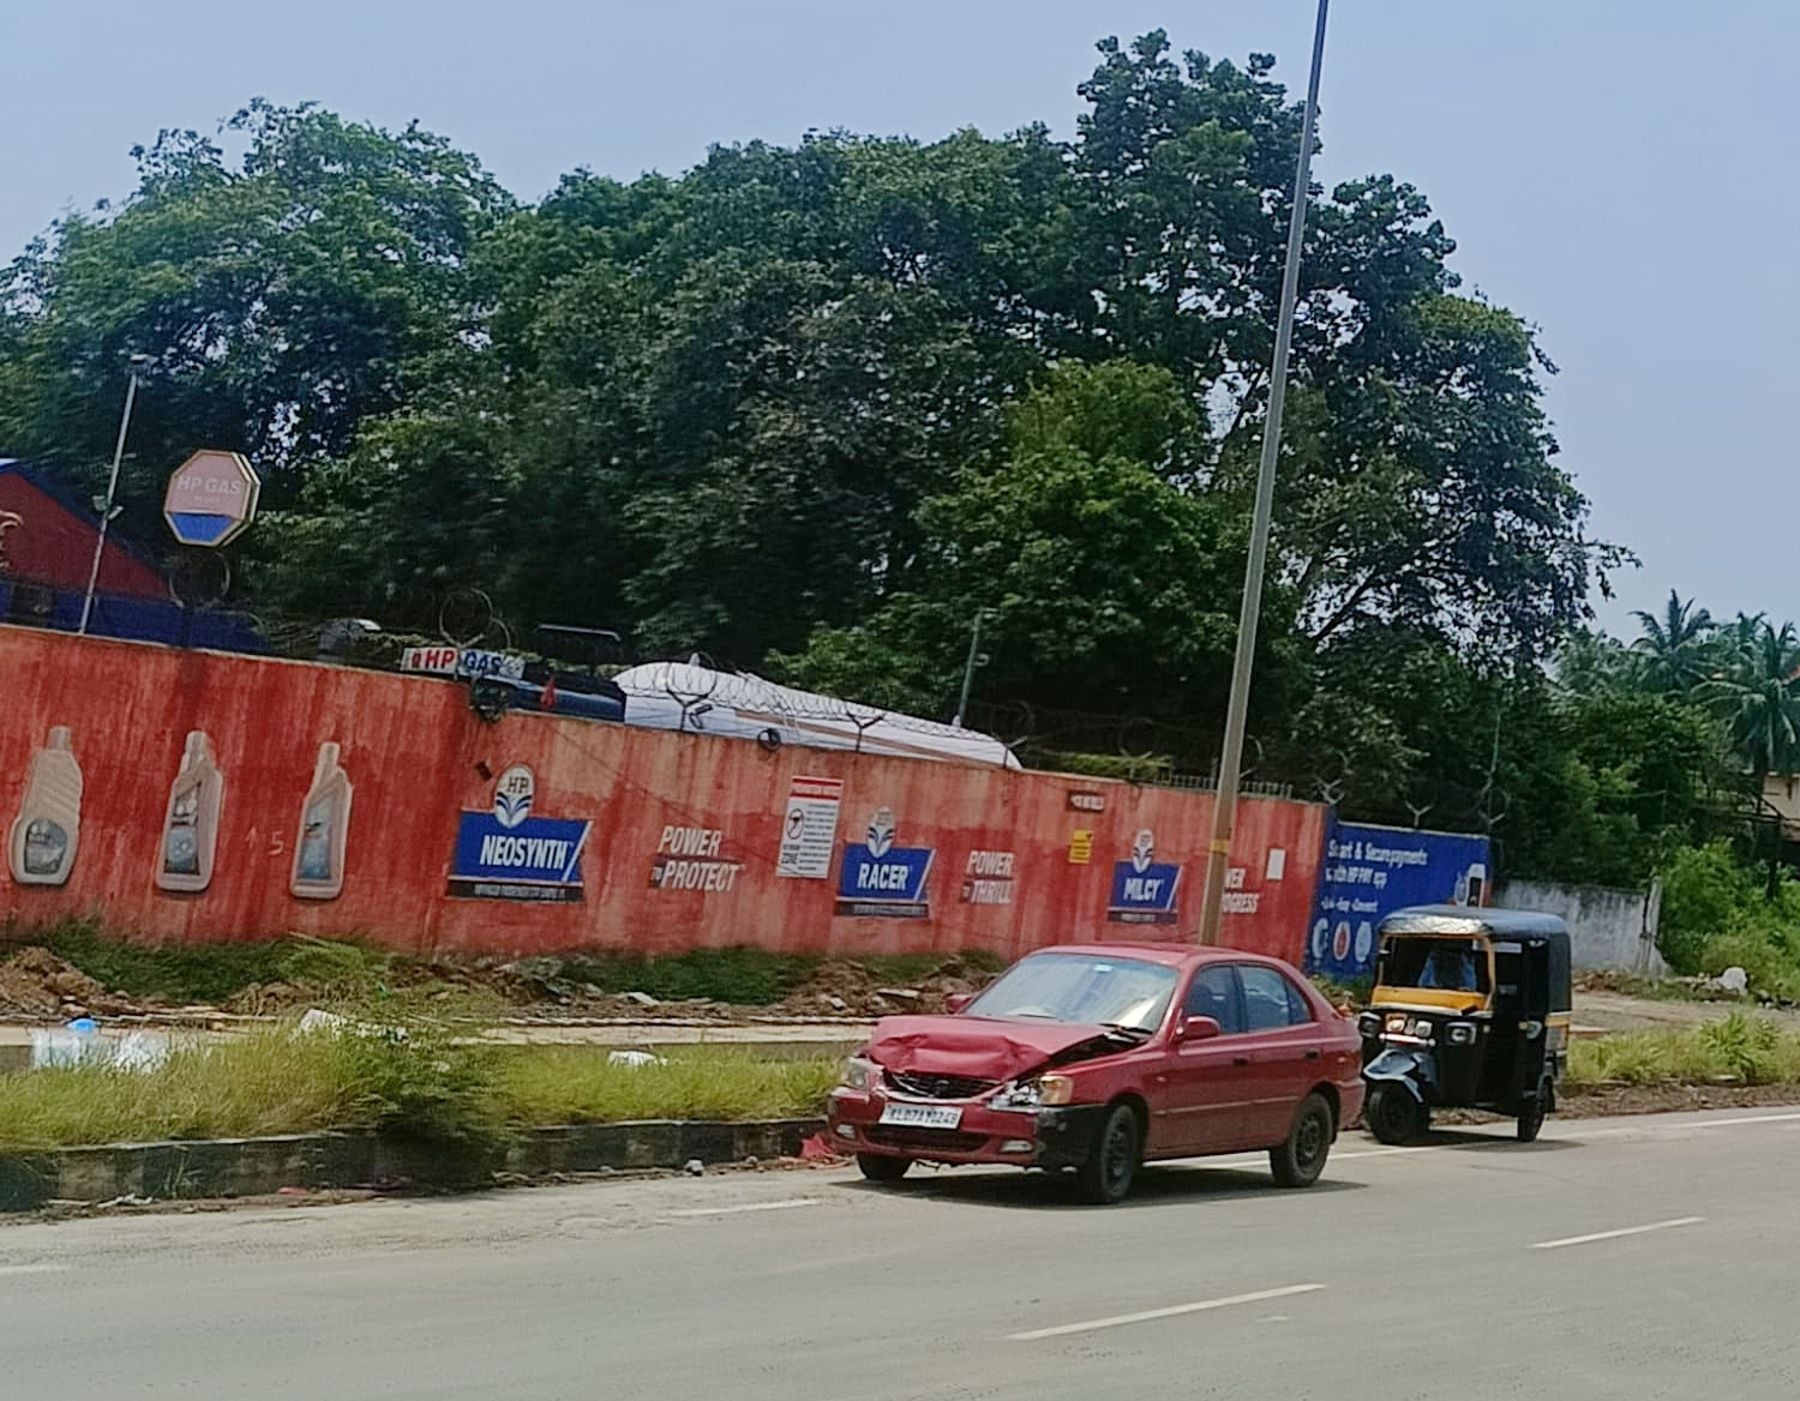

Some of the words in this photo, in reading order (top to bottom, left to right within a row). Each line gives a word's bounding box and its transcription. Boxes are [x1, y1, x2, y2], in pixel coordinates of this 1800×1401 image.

[425, 649, 455, 670] HP
[464, 651, 501, 676] GAS
[507, 776, 530, 794] HP
[480, 834, 568, 870] NEOSYNTH
[656, 825, 722, 857] POWER
[659, 860, 740, 892] PROTECT
[857, 863, 909, 891] RACER
[966, 850, 1014, 877] POWER
[970, 880, 1015, 904] THRILL
[1123, 877, 1161, 901] MILCY
